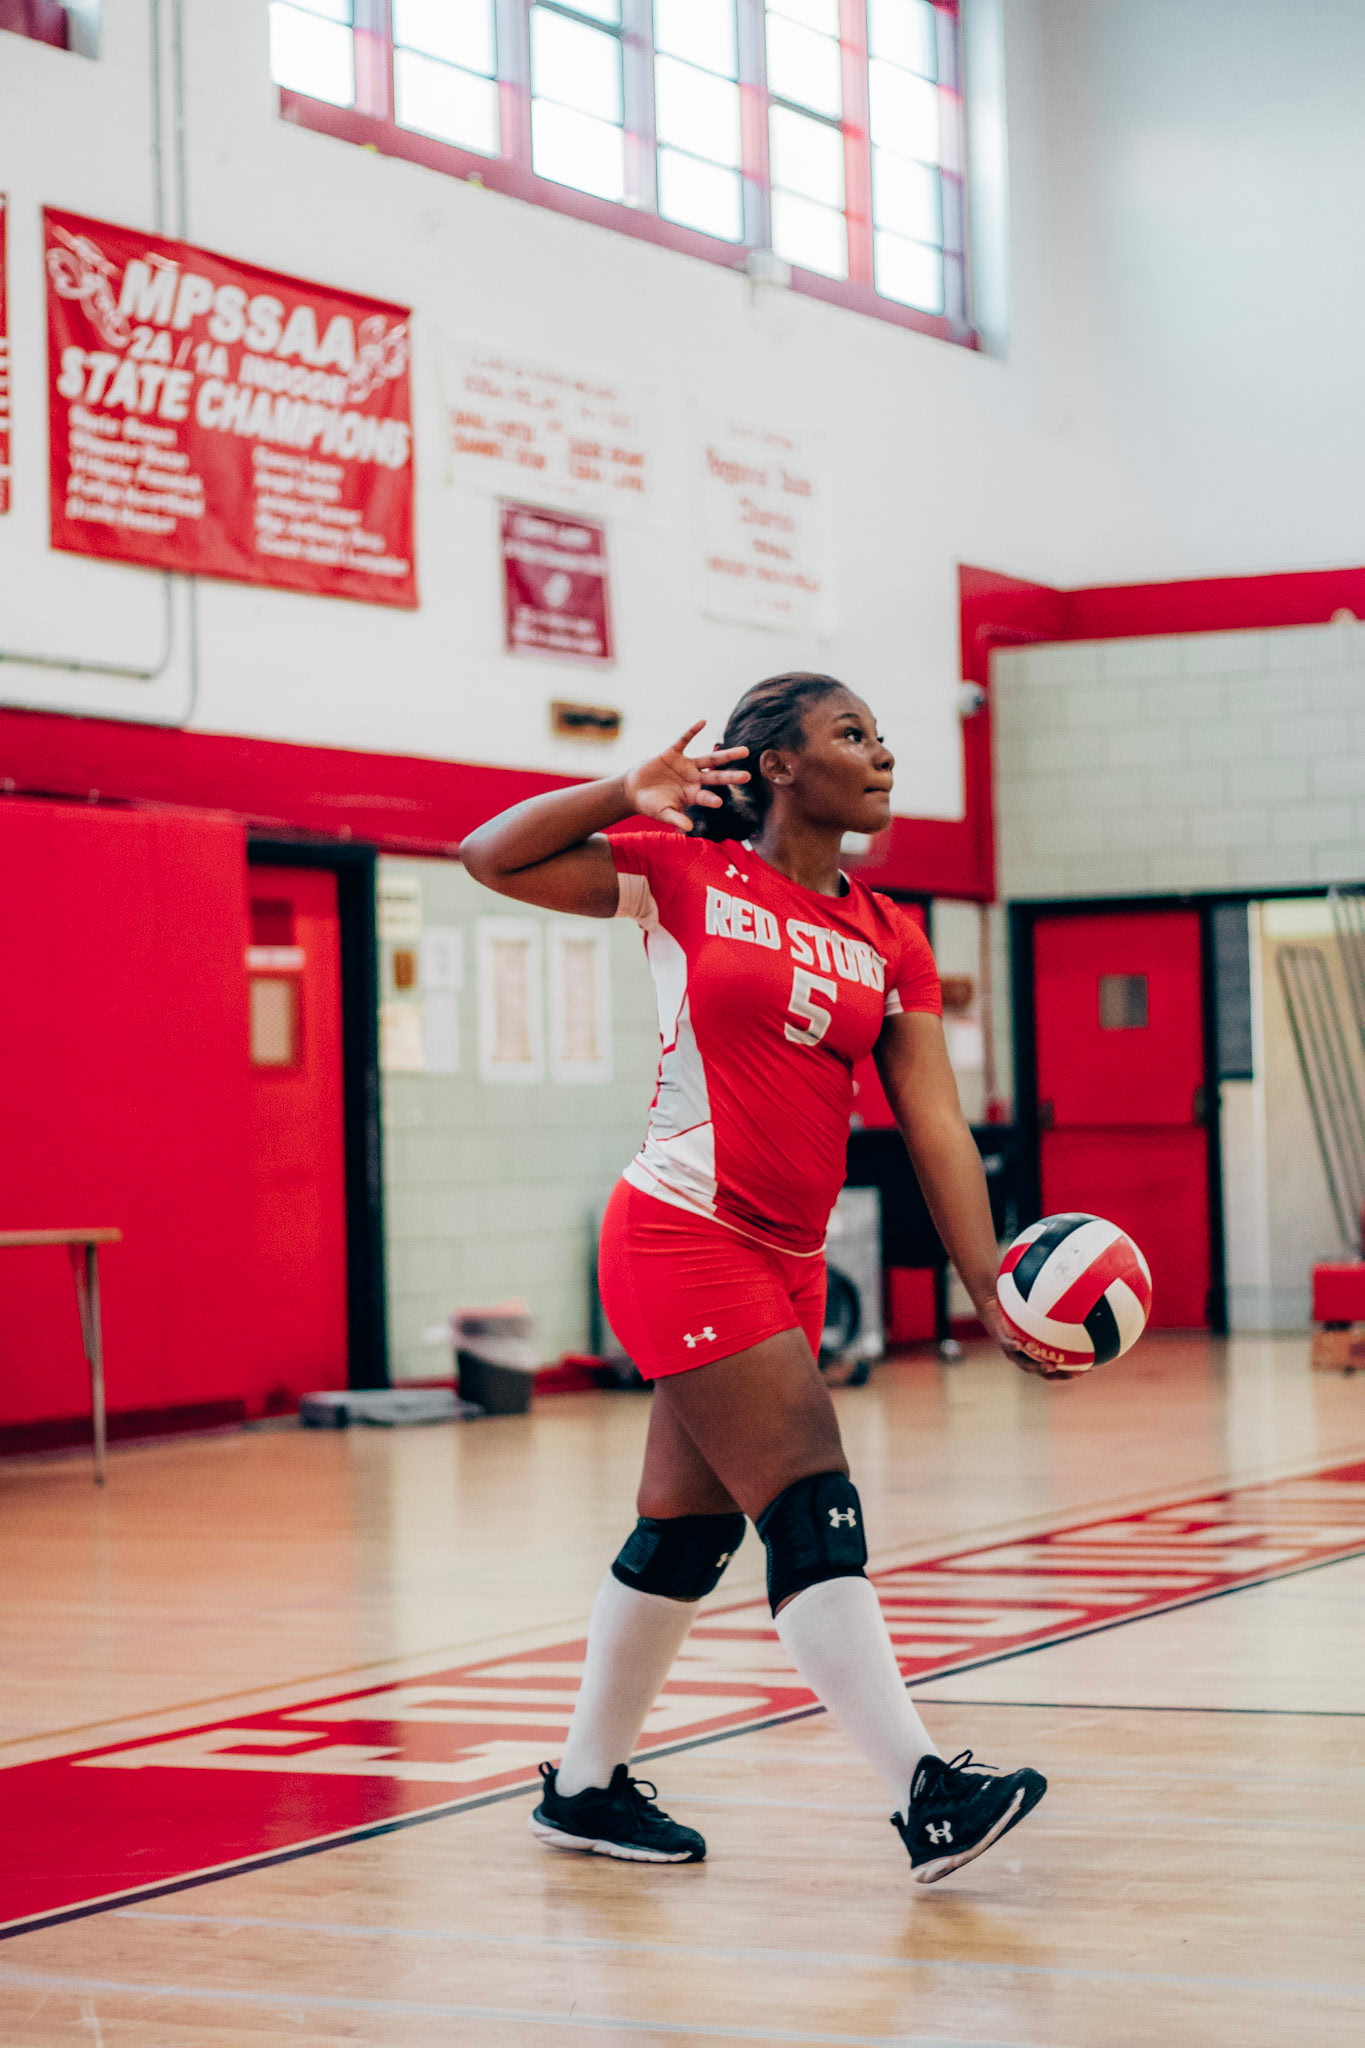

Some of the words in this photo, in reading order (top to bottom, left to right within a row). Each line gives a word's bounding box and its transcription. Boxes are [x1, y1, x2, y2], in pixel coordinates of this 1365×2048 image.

[118, 258, 356, 374] MPSSAA
[57, 345, 194, 423] STATE
[198, 377, 411, 469] CHAMPIONS
[705, 885, 781, 950] RED
[784, 966, 837, 1046] 5
